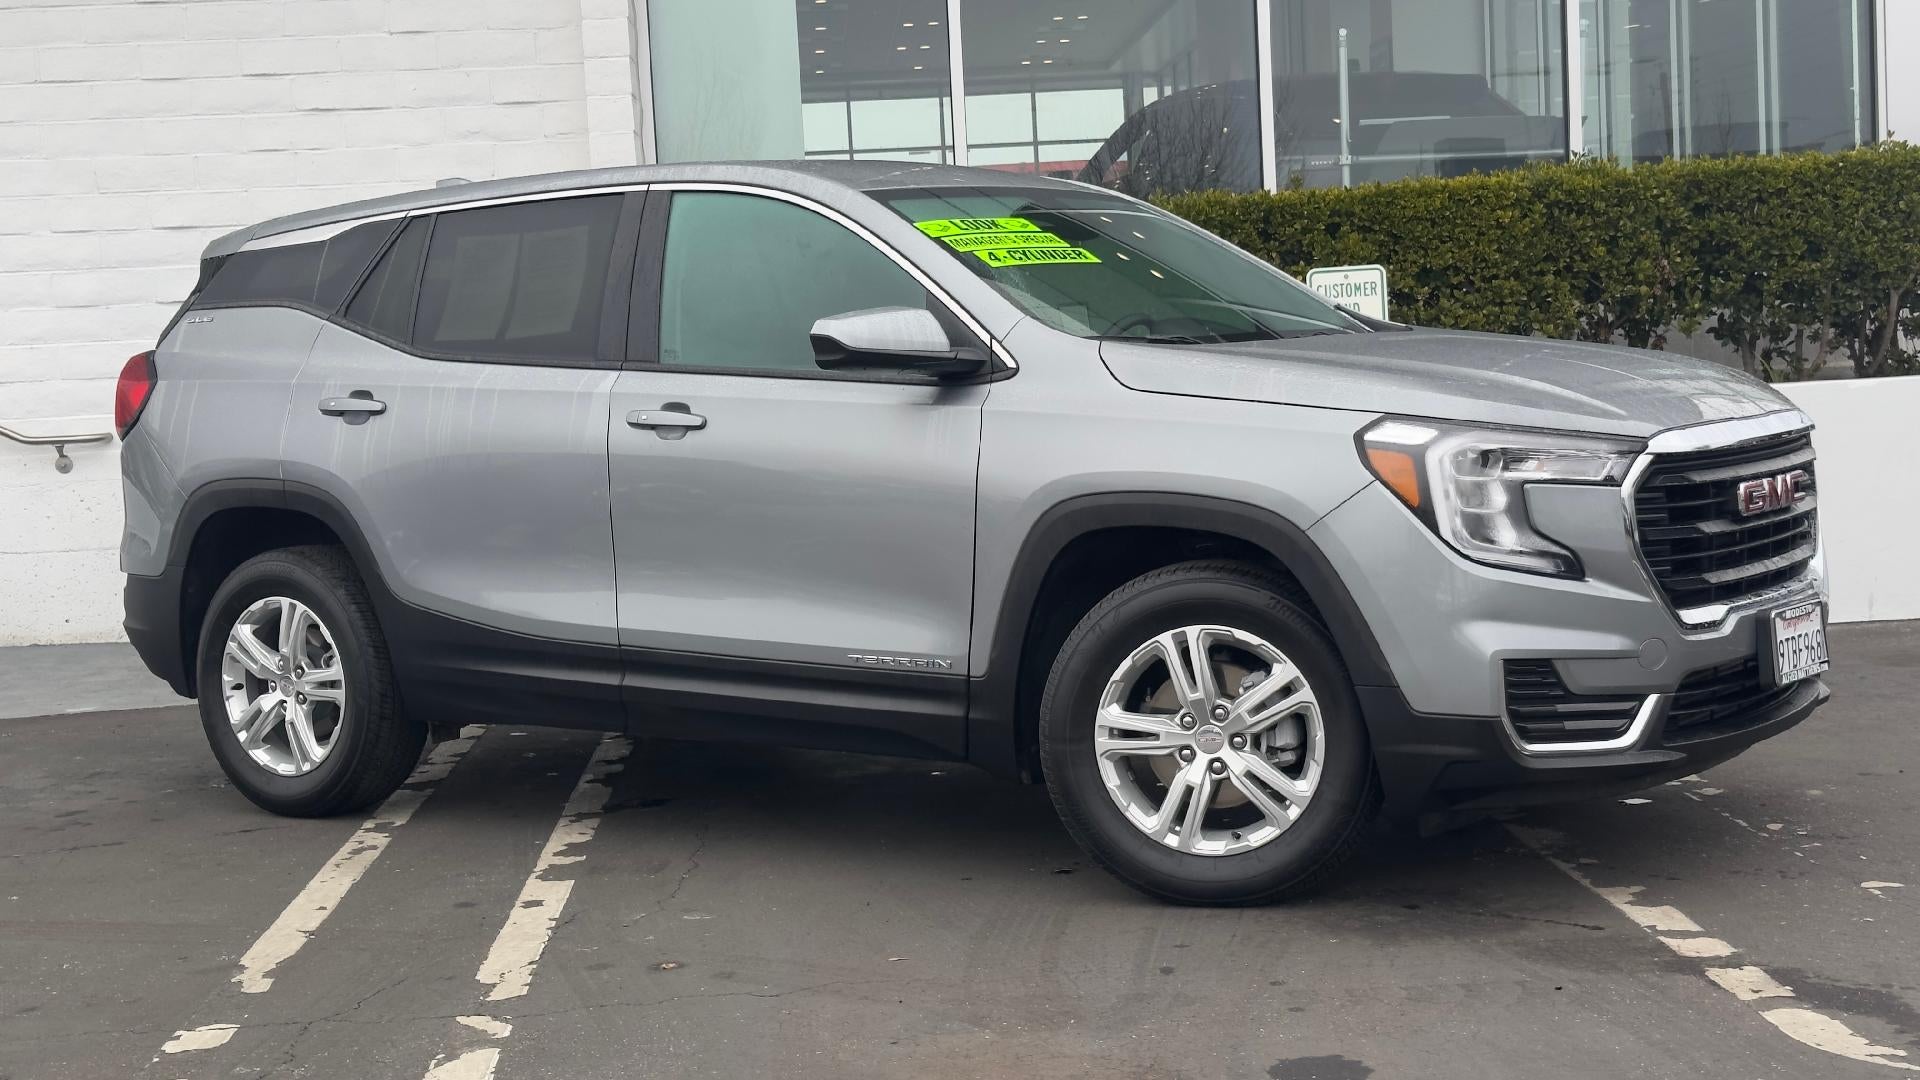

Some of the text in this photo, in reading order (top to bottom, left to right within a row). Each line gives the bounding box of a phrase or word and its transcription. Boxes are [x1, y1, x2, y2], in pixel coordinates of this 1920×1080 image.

[949, 219, 1008, 231] LOOK
[949, 234, 1064, 248] MANAGER'S SPECIAL
[1737, 469, 1809, 516] GMC
[1778, 629, 1821, 673] 9TBF968
[847, 654, 952, 669] TERRAIN
